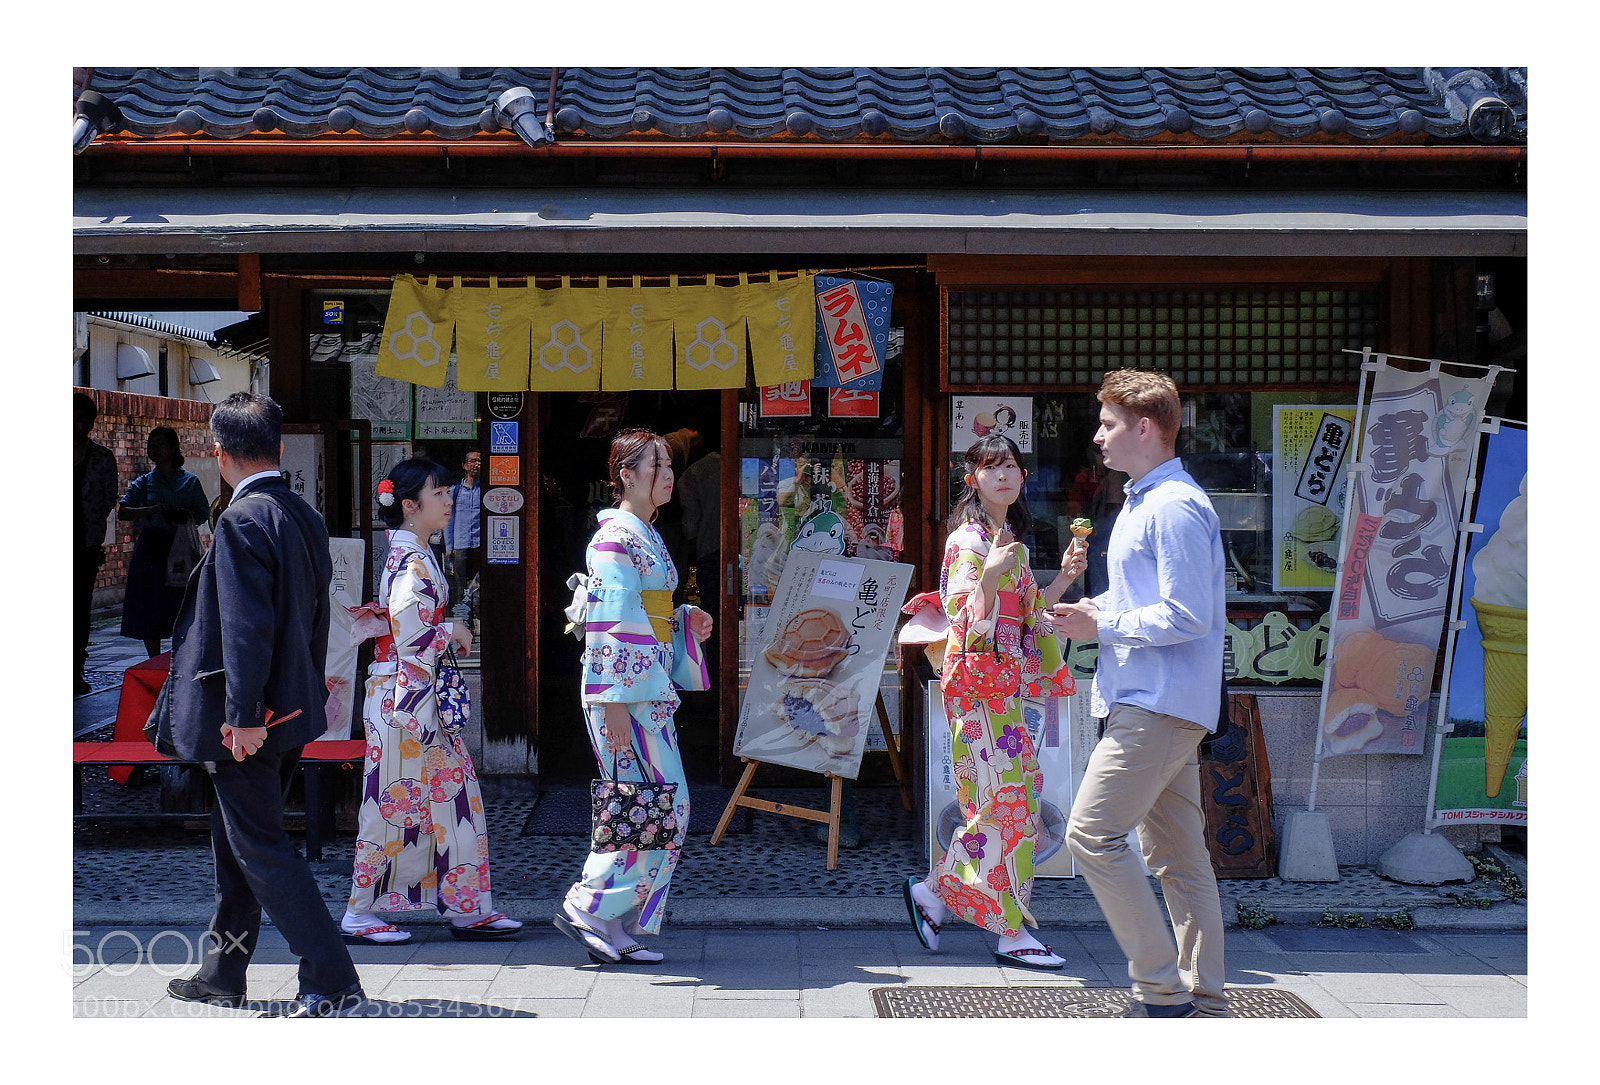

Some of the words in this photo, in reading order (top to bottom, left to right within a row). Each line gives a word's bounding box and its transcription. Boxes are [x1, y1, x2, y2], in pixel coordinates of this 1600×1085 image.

[823, 288, 873, 375] ラムネ
[801, 442, 857, 454] KAMEYA
[1018, 420, 1030, 449] 販売中
[1308, 422, 1345, 496] 亀どら
[760, 463, 778, 512] バニラ
[867, 461, 880, 517] 北海道小倉
[331, 552, 348, 596] 小江戸
[845, 576, 878, 656] 亀どら
[872, 575, 899, 631] 元町店限定
[1209, 762, 1255, 855] どら
[1441, 811, 1464, 820] TOMI
